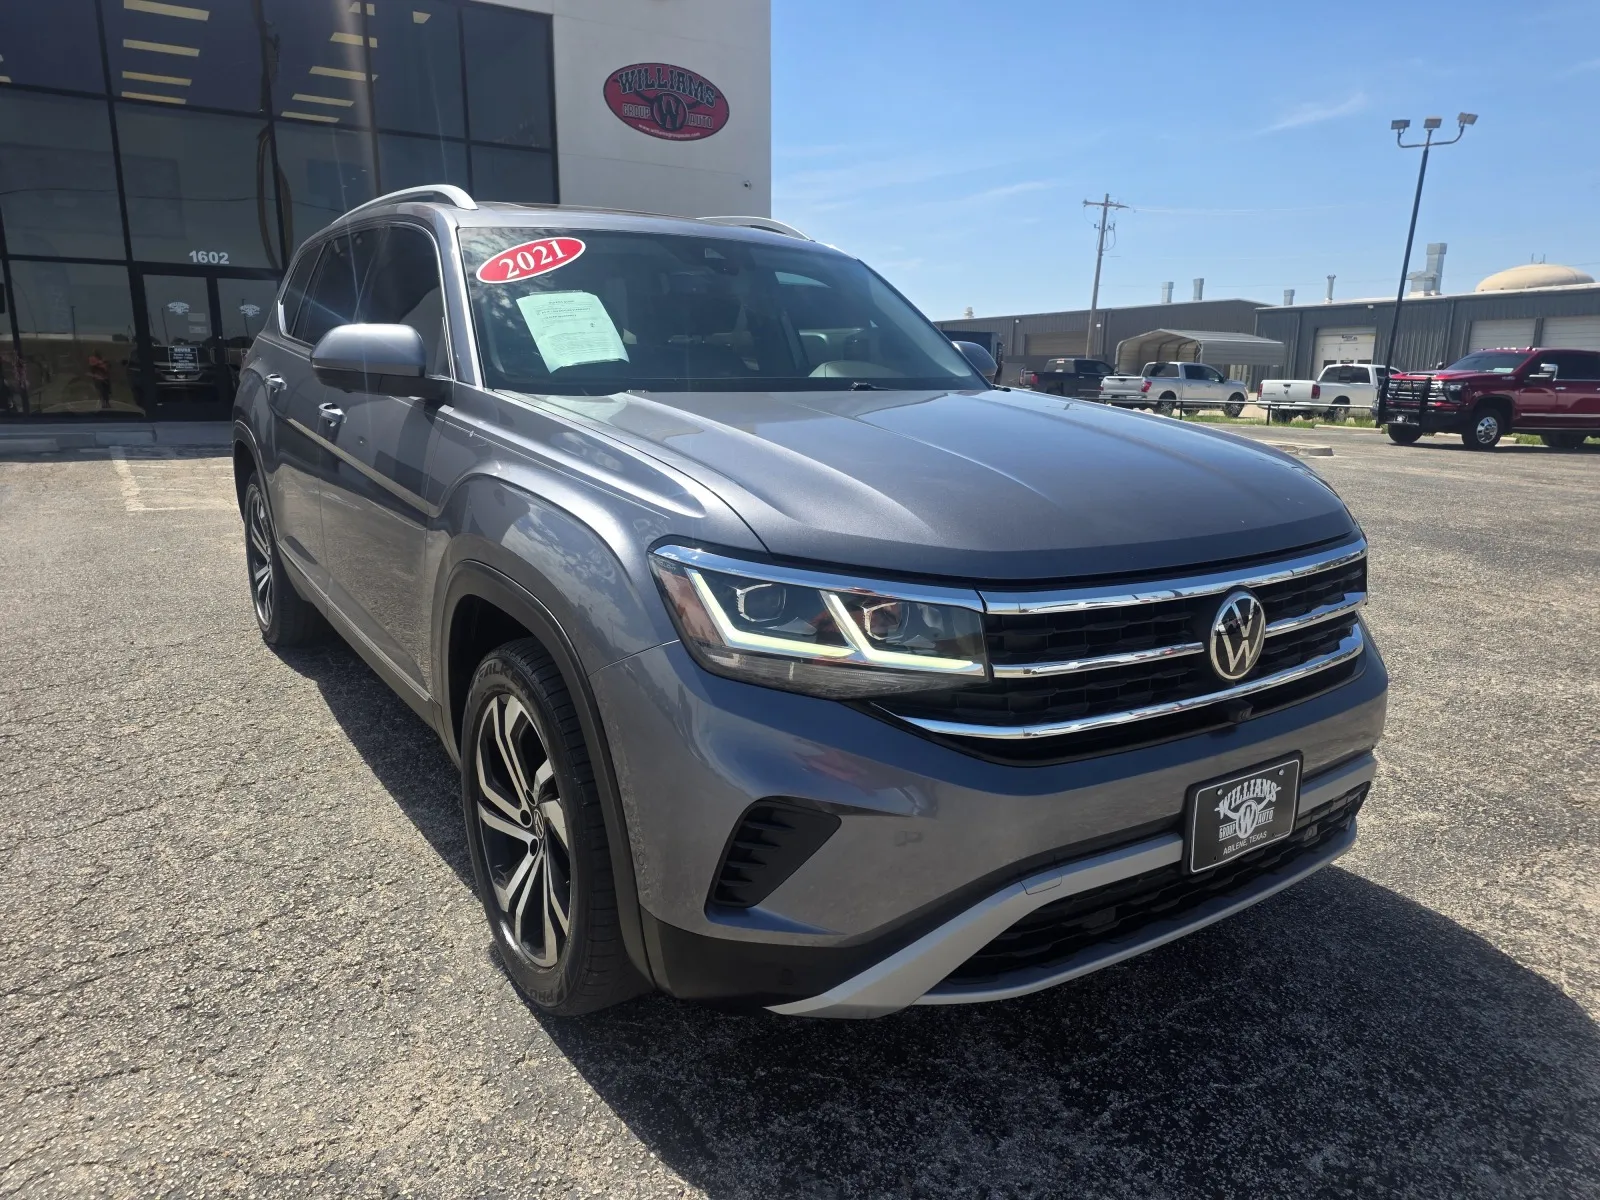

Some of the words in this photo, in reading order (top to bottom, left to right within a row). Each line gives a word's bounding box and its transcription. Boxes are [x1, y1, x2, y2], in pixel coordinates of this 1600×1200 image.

[618, 67, 716, 108] WILLIAMS
[622, 103, 651, 119] GROUP
[688, 113, 714, 129] AUTO
[189, 250, 230, 265] 1602
[498, 239, 568, 279] 2021
[1218, 779, 1277, 819] WILLIAMS
[1218, 824, 1237, 839] GROUP
[1257, 809, 1274, 824] AUTO
[1223, 840, 1248, 855] ABILENE,
[1249, 831, 1267, 843] TEXAS
